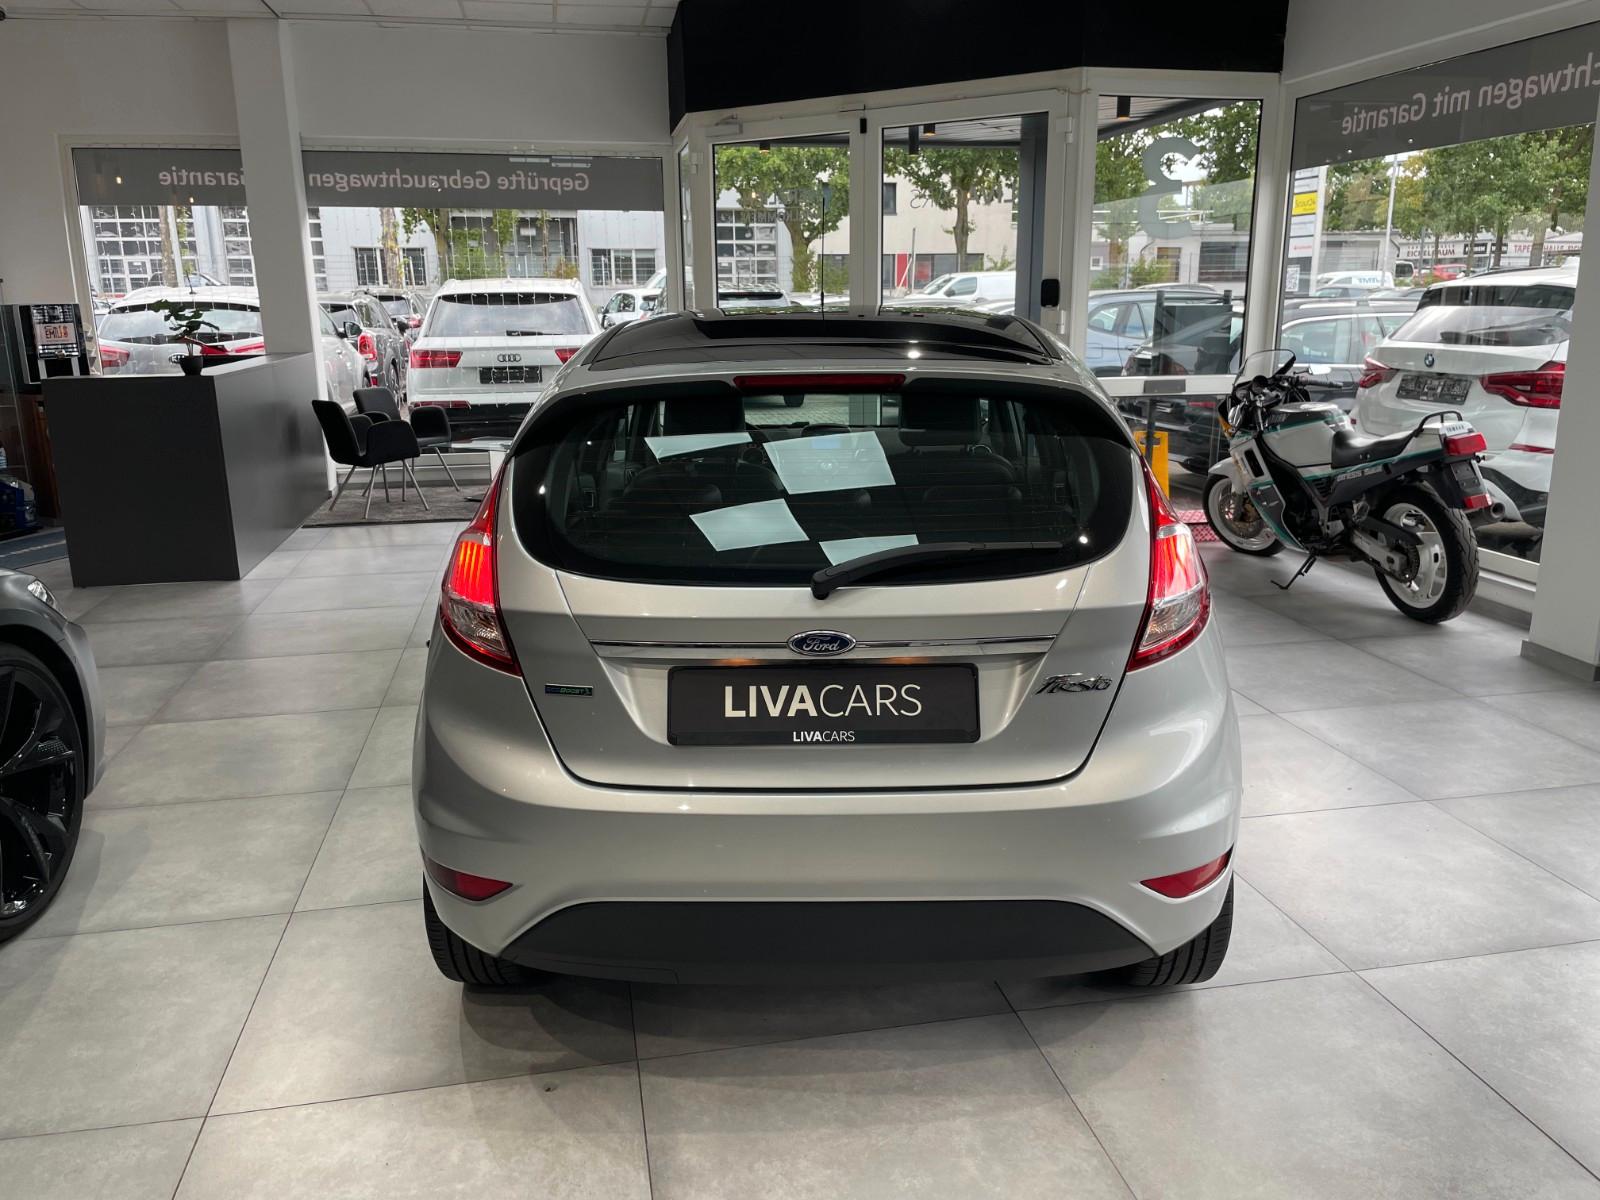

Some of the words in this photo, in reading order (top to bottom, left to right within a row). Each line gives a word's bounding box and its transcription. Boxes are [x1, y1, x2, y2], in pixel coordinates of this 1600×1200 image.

[802, 636, 840, 651] Ford
[1035, 673, 1112, 695] Fiesta
[725, 684, 922, 717] LIVACARS
[793, 730, 855, 742] LIVACARS
